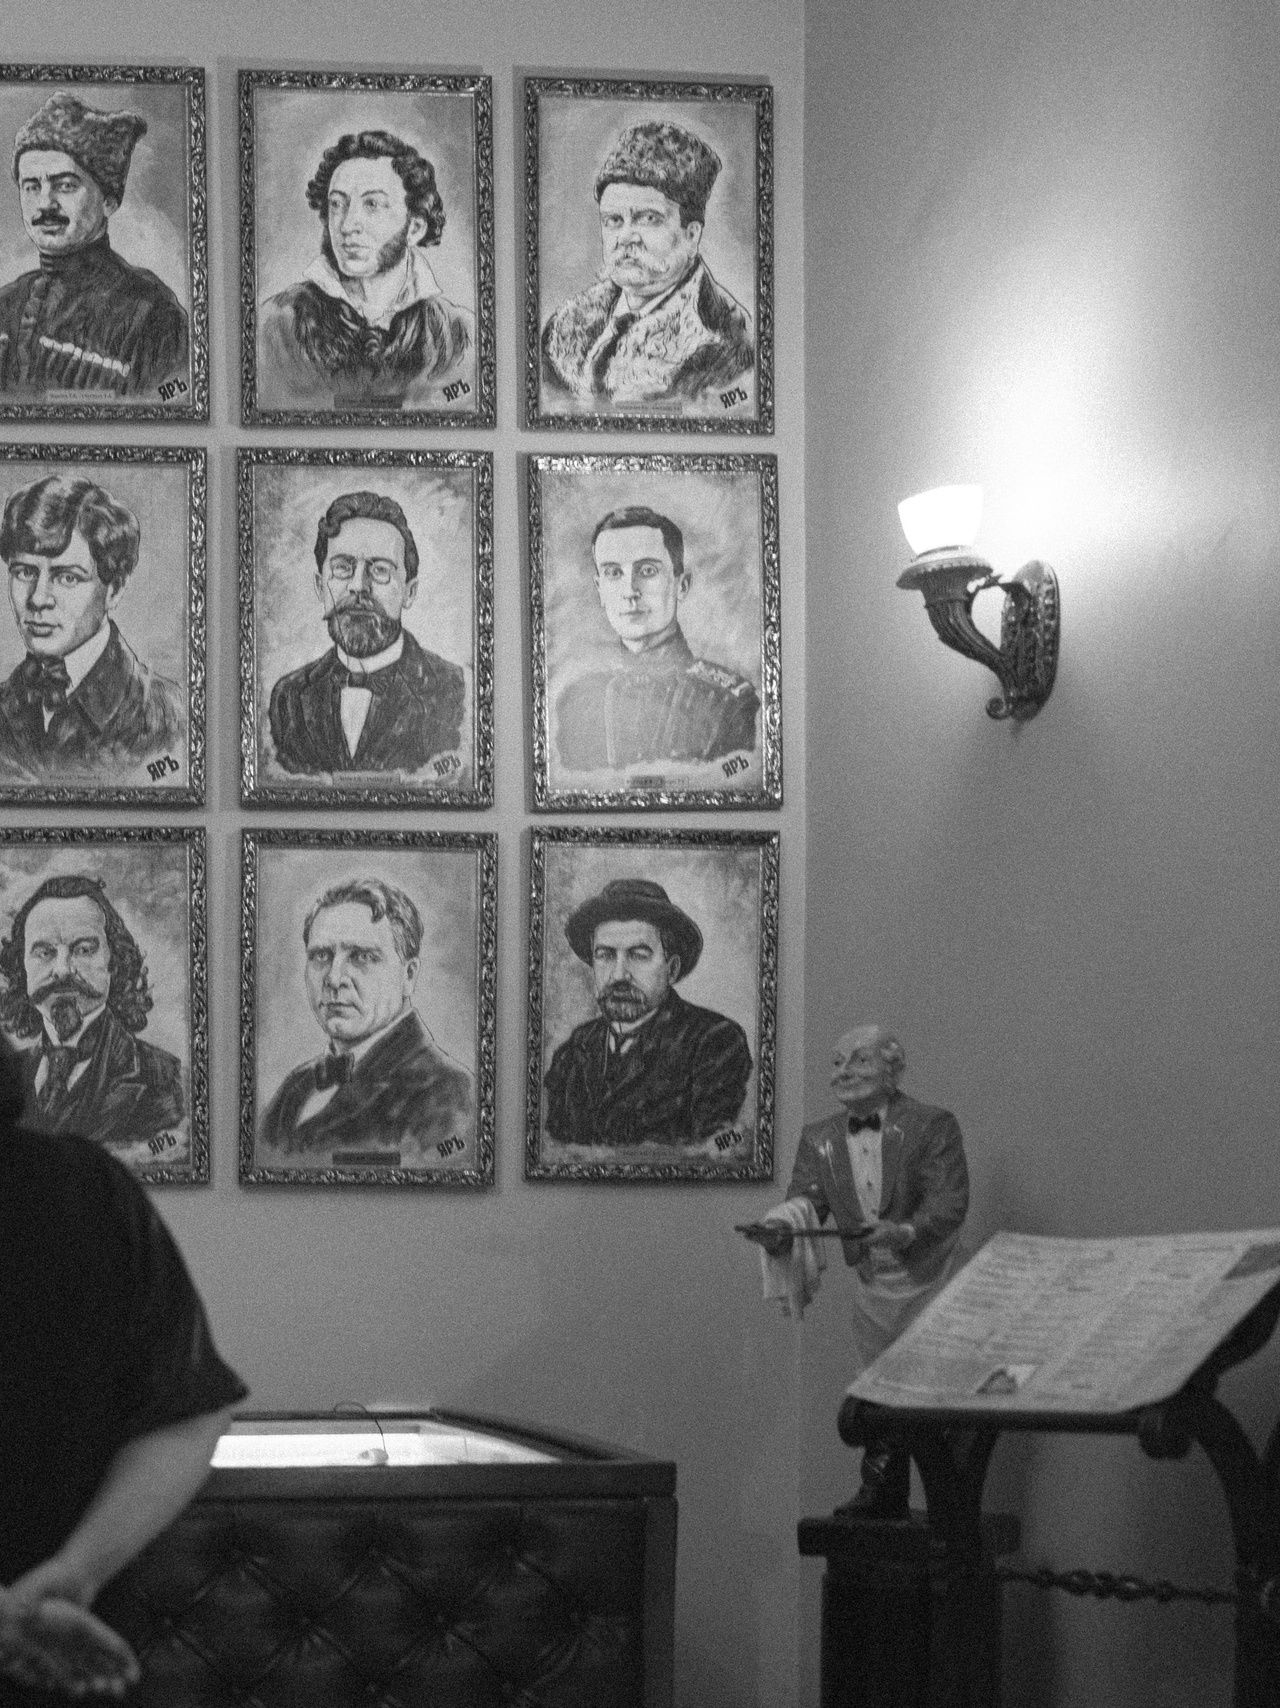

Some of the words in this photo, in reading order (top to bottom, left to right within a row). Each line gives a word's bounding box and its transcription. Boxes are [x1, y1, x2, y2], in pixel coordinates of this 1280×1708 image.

[158, 377, 188, 401] ЯРЪ
[442, 379, 471, 402] ЯРЪ
[720, 386, 748, 409] ЯРЪ
[146, 755, 180, 782] ЯРЪ
[433, 754, 462, 777] ЯРЪ
[722, 755, 749, 778] ЯРЪ
[148, 1131, 177, 1155] ЯРЪ
[436, 1135, 465, 1158] ЯРЪ
[714, 1129, 742, 1151] ЯРЪ
